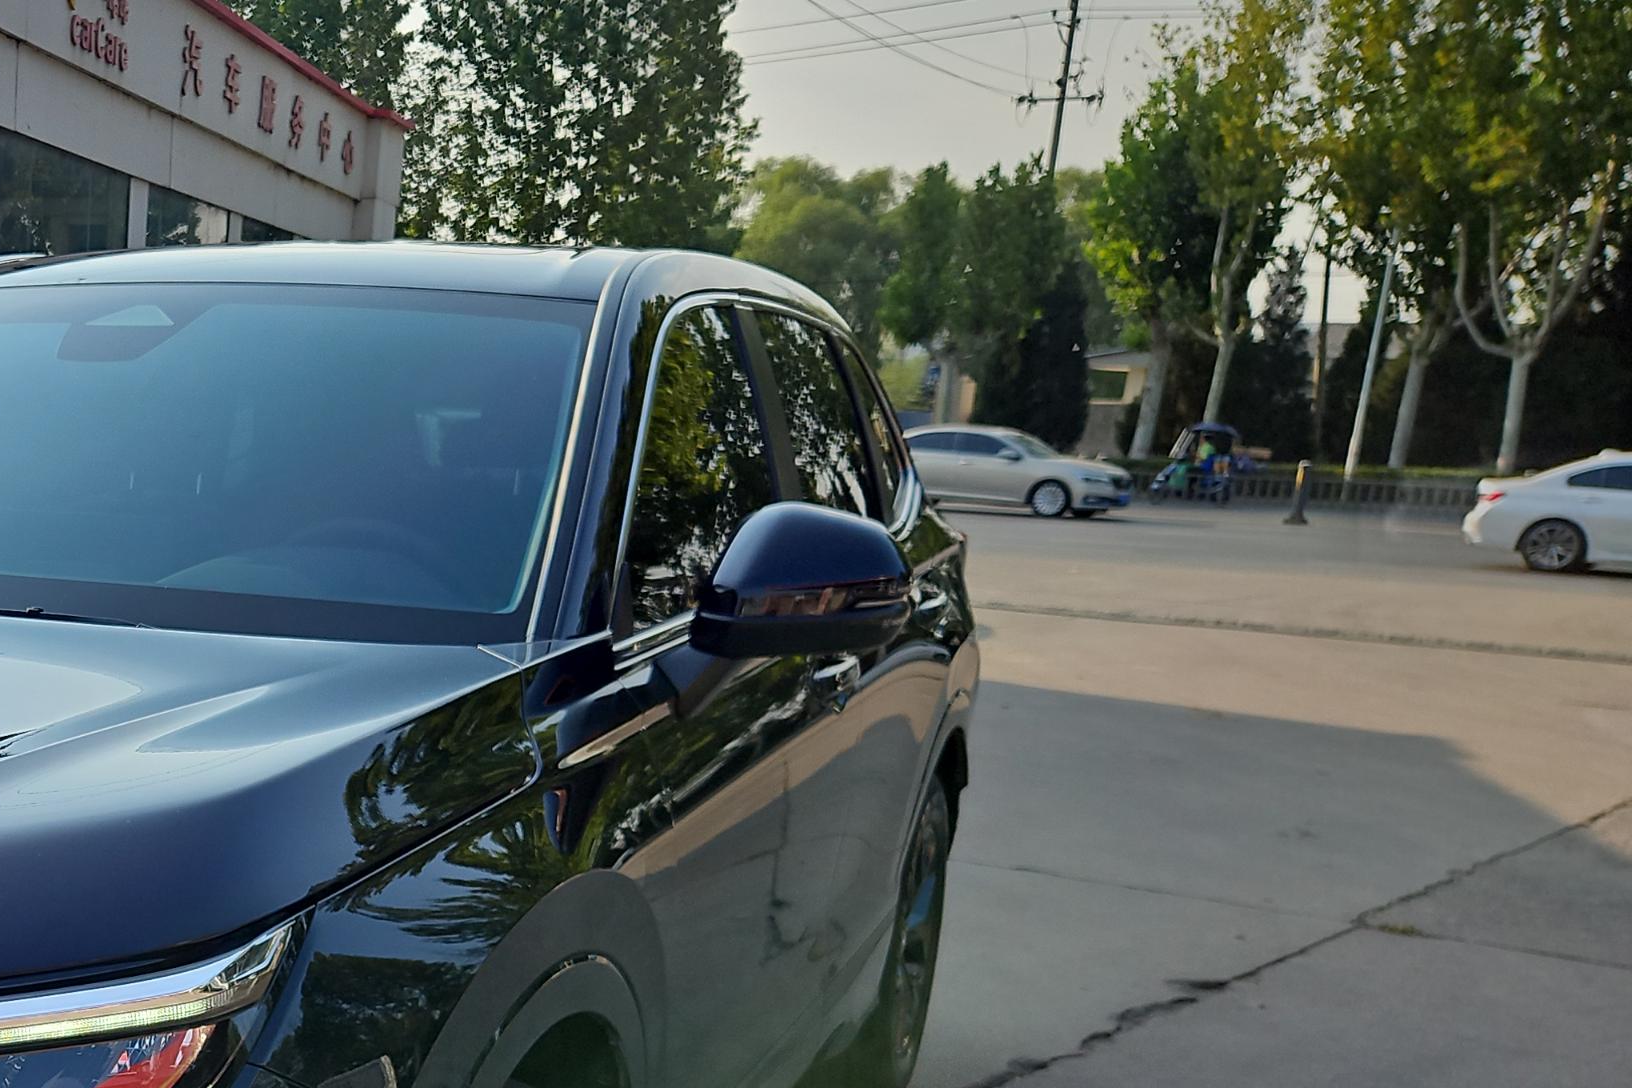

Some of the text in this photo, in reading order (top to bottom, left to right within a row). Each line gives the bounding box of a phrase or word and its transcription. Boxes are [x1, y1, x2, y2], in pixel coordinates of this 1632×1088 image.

[181, 24, 354, 175] 汽车服务中心
